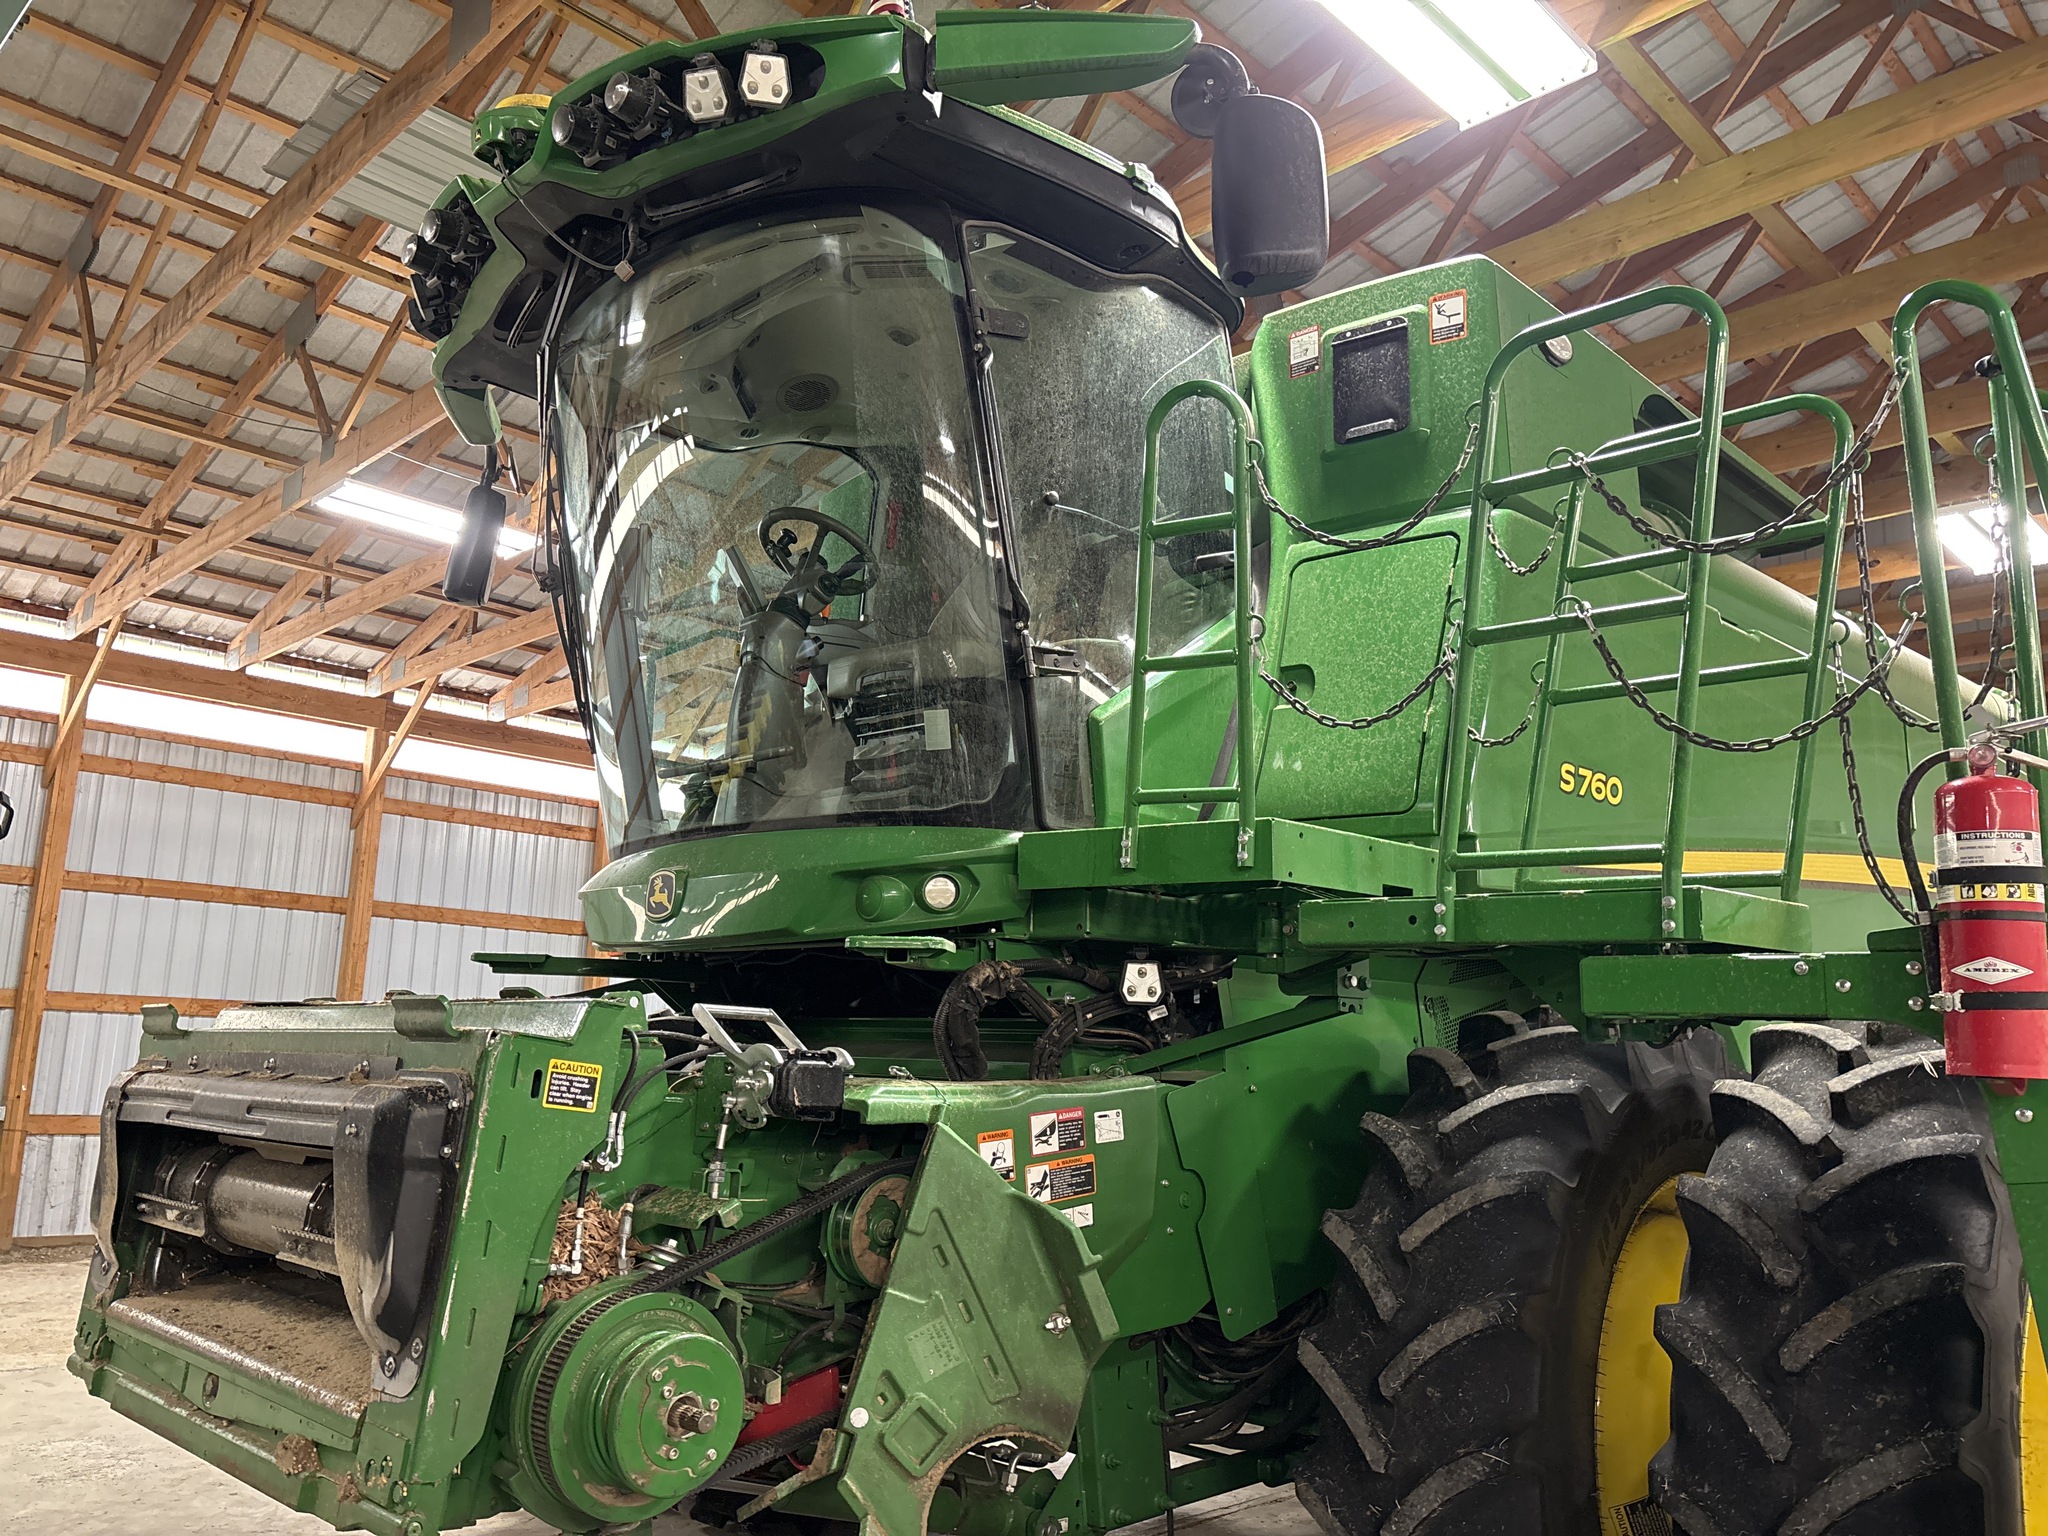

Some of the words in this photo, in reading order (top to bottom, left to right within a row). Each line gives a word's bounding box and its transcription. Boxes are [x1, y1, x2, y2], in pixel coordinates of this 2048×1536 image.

[1296, 325, 1318, 336] DANGER
[1560, 761, 1623, 807] S760
[1961, 832, 2026, 840] INSTRUCTIONS
[2027, 884, 2036, 899] ABC
[560, 1063, 599, 1075] CAUTION
[1063, 1110, 1082, 1119] DANGER
[987, 1131, 1009, 1140] WARNING
[1061, 1157, 1083, 1166] WARNING
[1614, 1506, 1631, 1536] AUTION
